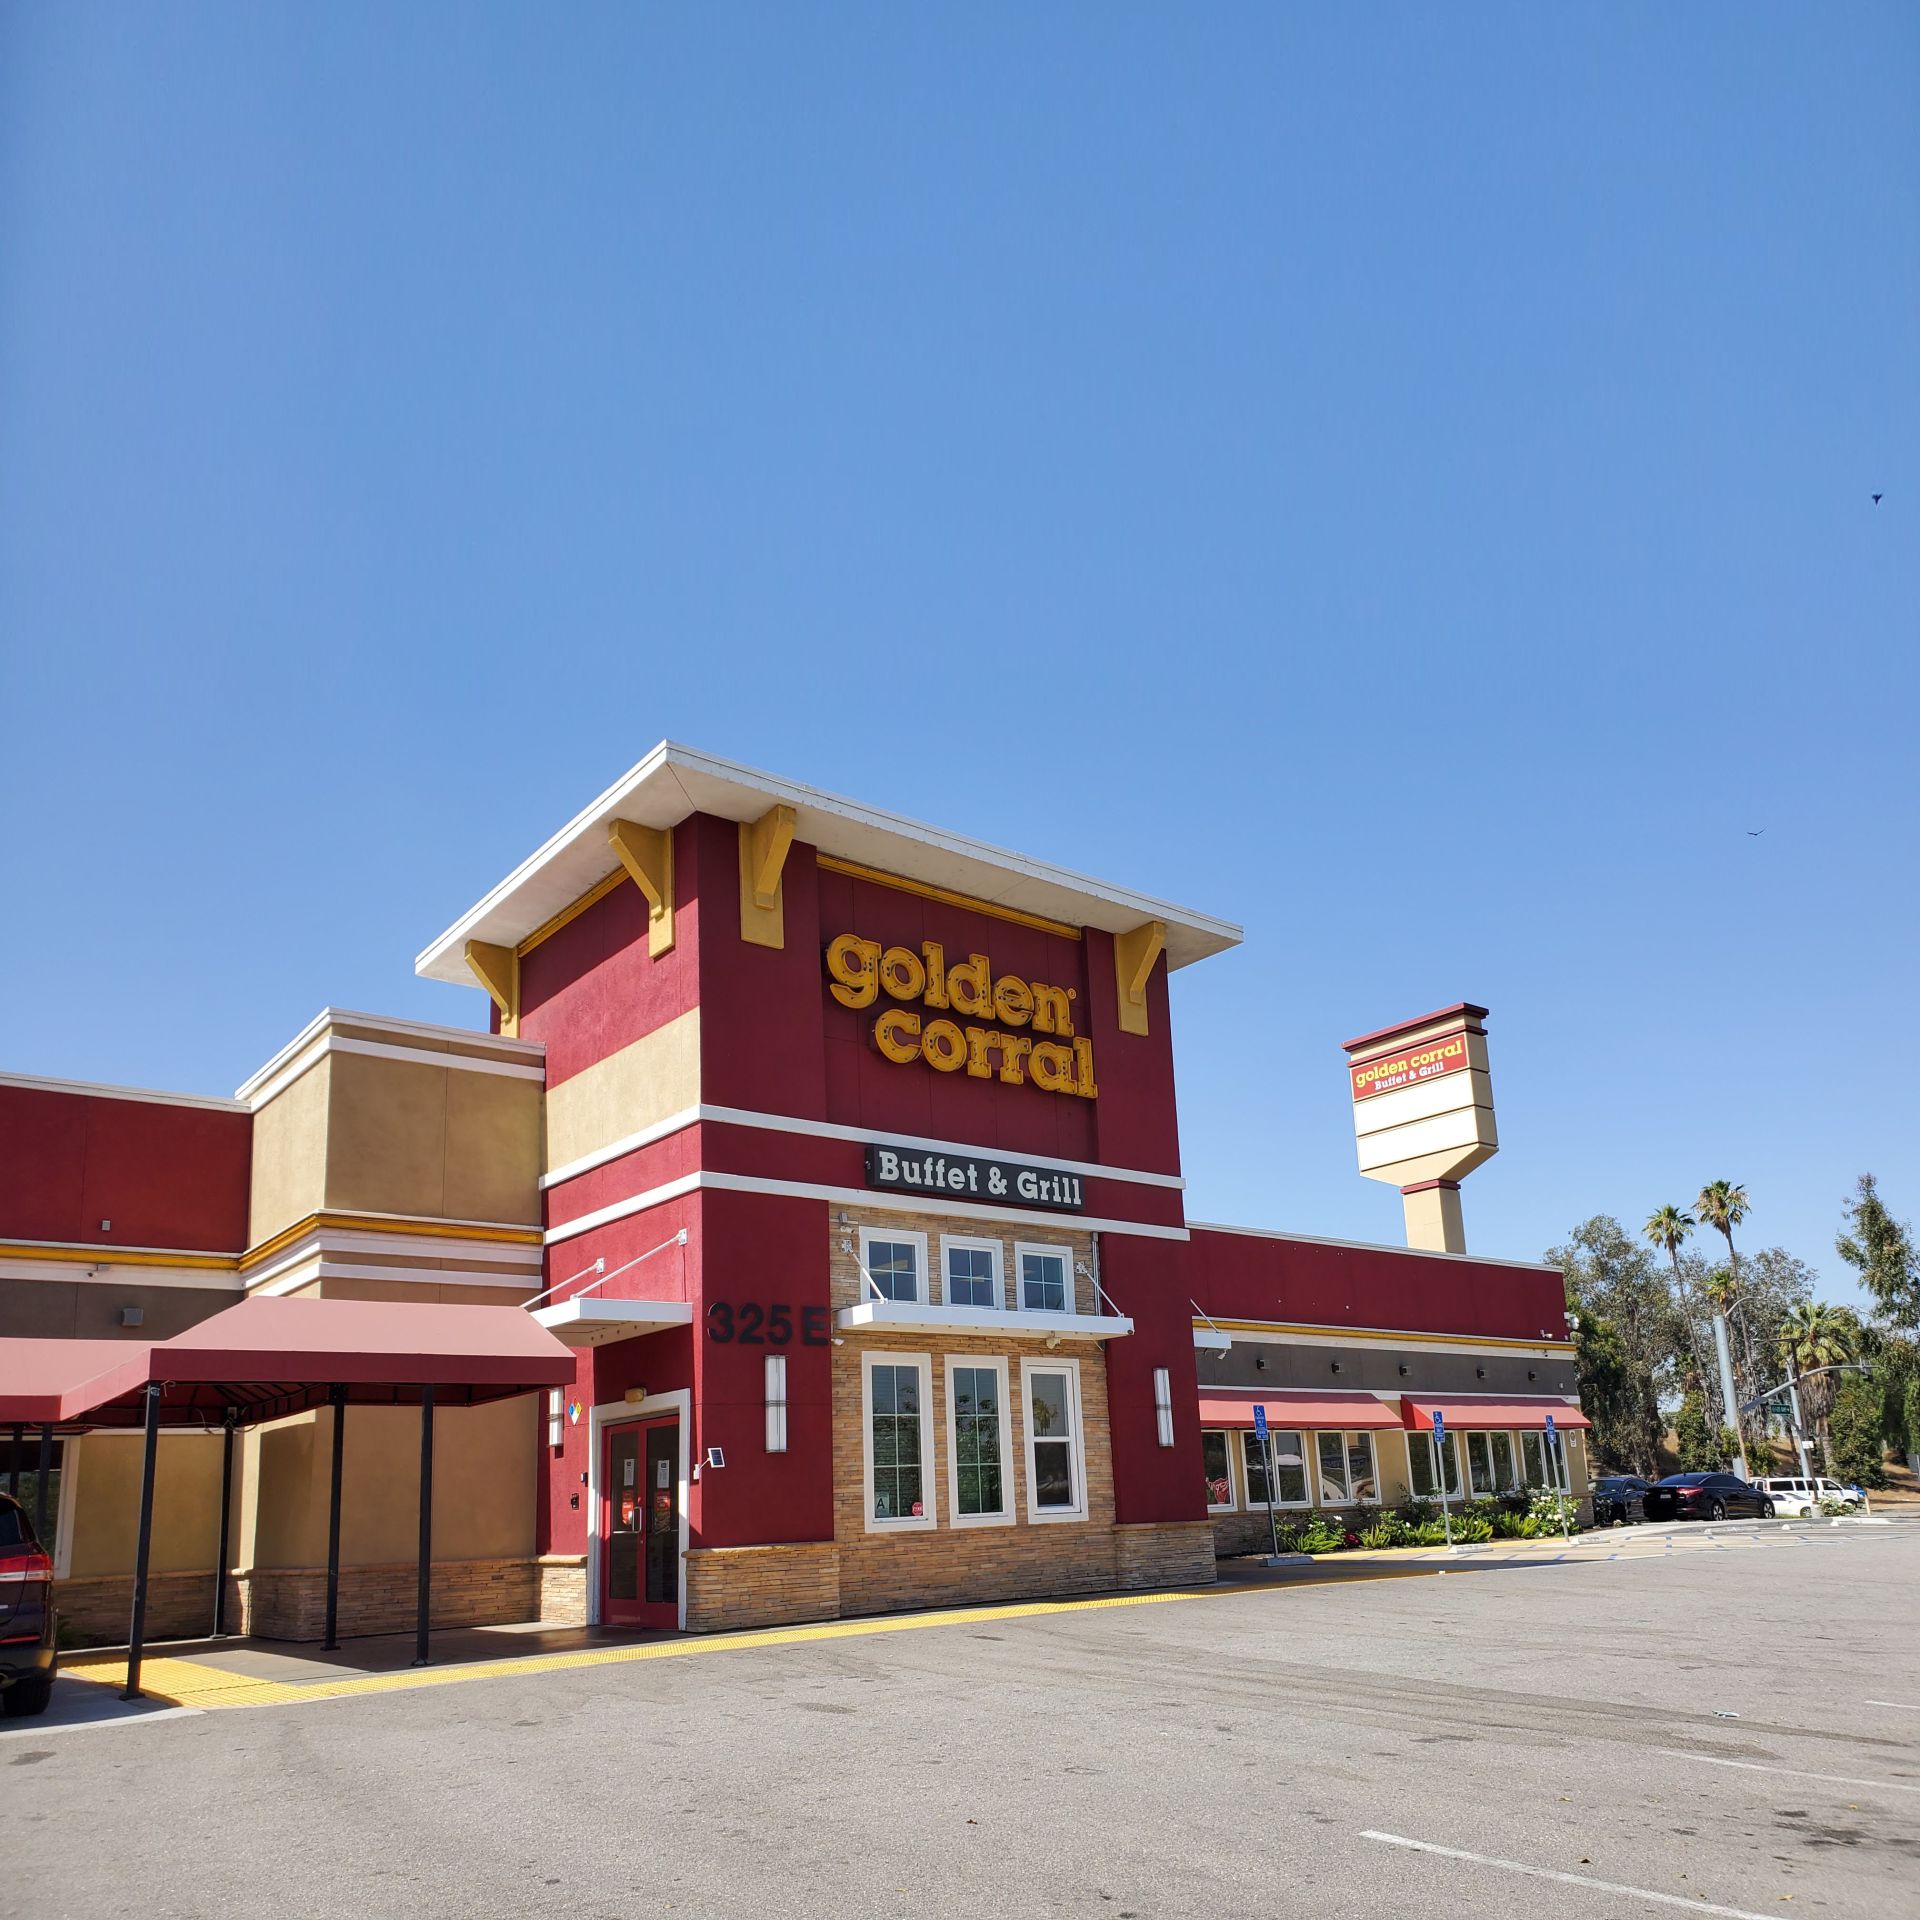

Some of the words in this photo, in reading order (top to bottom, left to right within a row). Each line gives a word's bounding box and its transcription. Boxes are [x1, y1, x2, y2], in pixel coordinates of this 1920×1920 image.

[827, 933, 1074, 1037] golden
[875, 1009, 1098, 1099] corral
[1356, 1060, 1408, 1087] golden
[1410, 1040, 1462, 1067] corral
[1374, 1073, 1407, 1090] Buffet
[1408, 1070, 1416, 1080] &
[1419, 1061, 1444, 1076] Grill
[878, 1151, 979, 1192] Buffet
[987, 1166, 1008, 1195] &
[1016, 1171, 1082, 1205] Grill
[707, 1302, 793, 1345] 325
[803, 1305, 829, 1345] E
